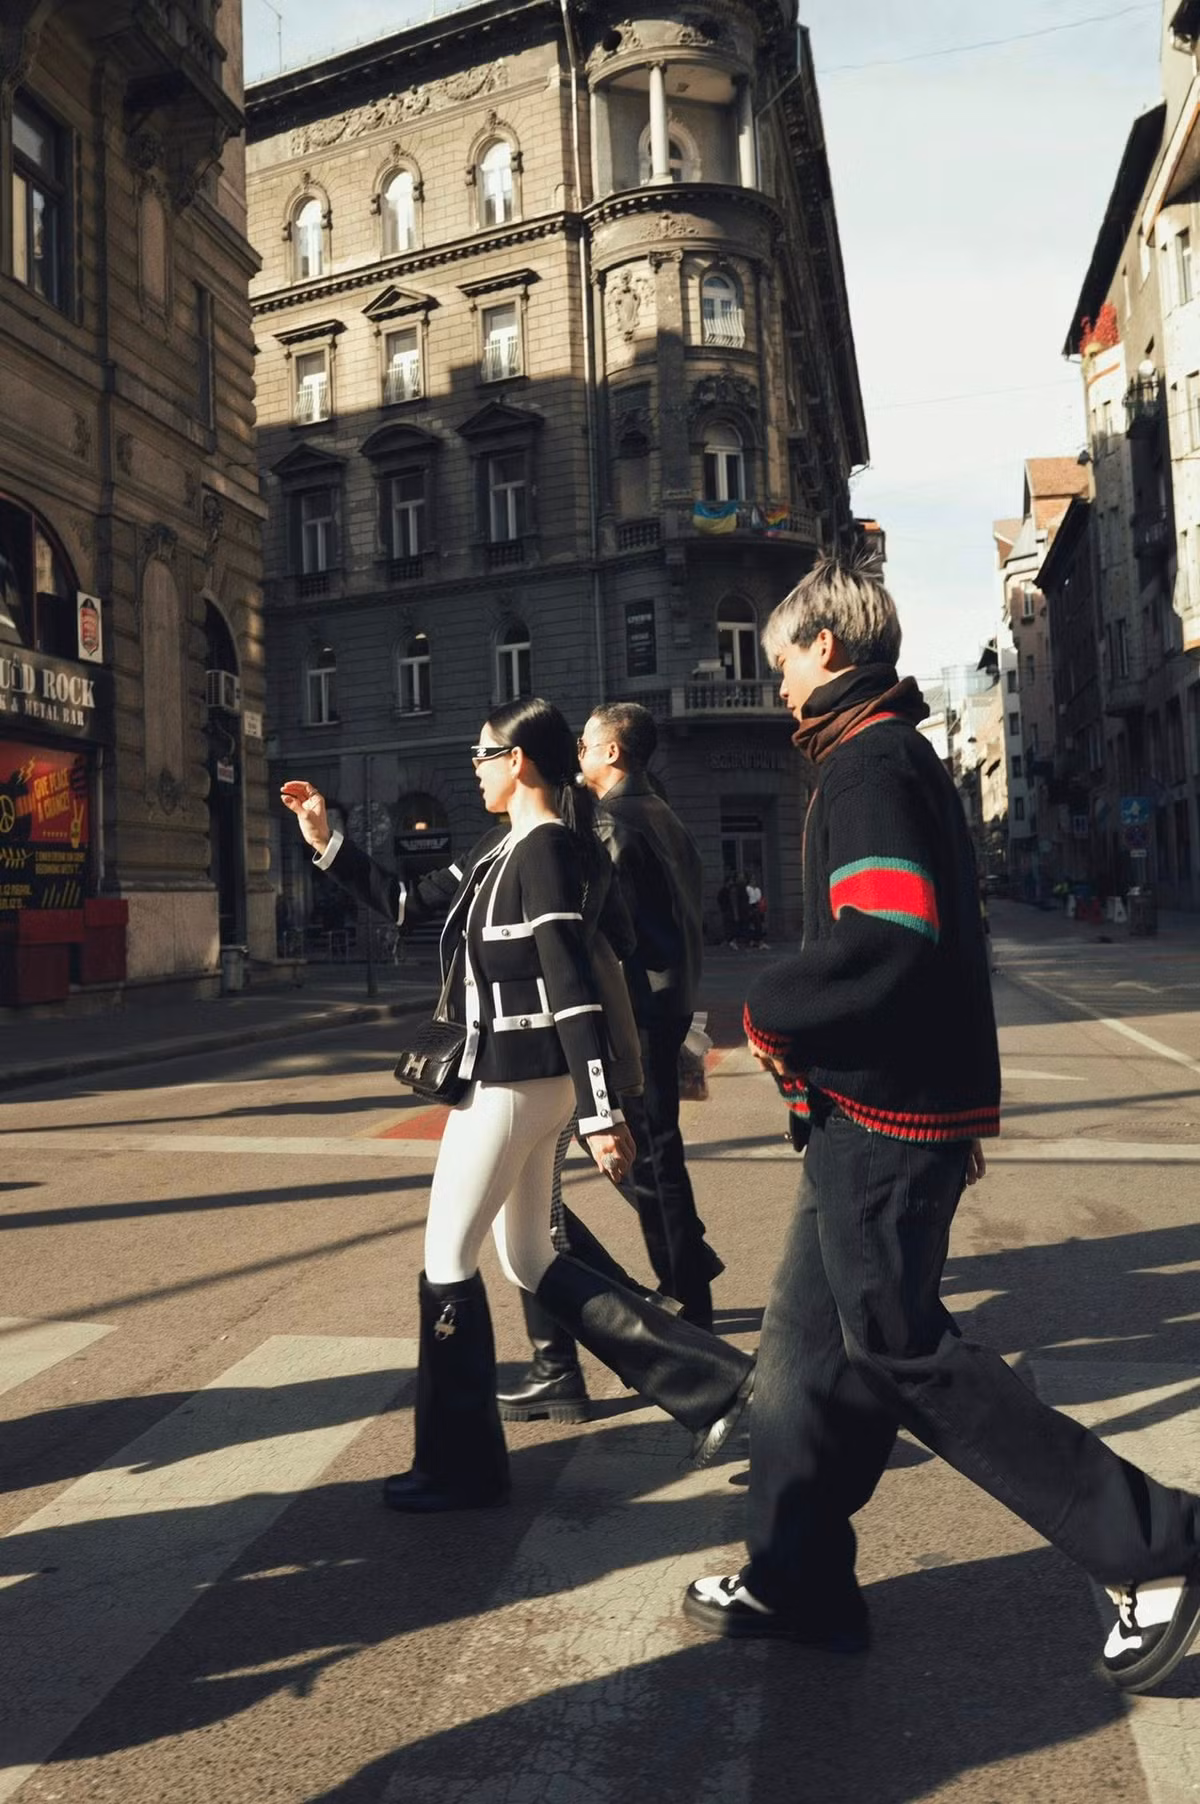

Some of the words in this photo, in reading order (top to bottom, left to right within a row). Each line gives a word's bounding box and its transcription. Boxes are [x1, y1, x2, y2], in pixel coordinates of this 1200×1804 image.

[42, 669, 95, 709] ROCK
[11, 697, 19, 713] &
[24, 699, 59, 721] METAL
[63, 708, 84, 726] BAR
